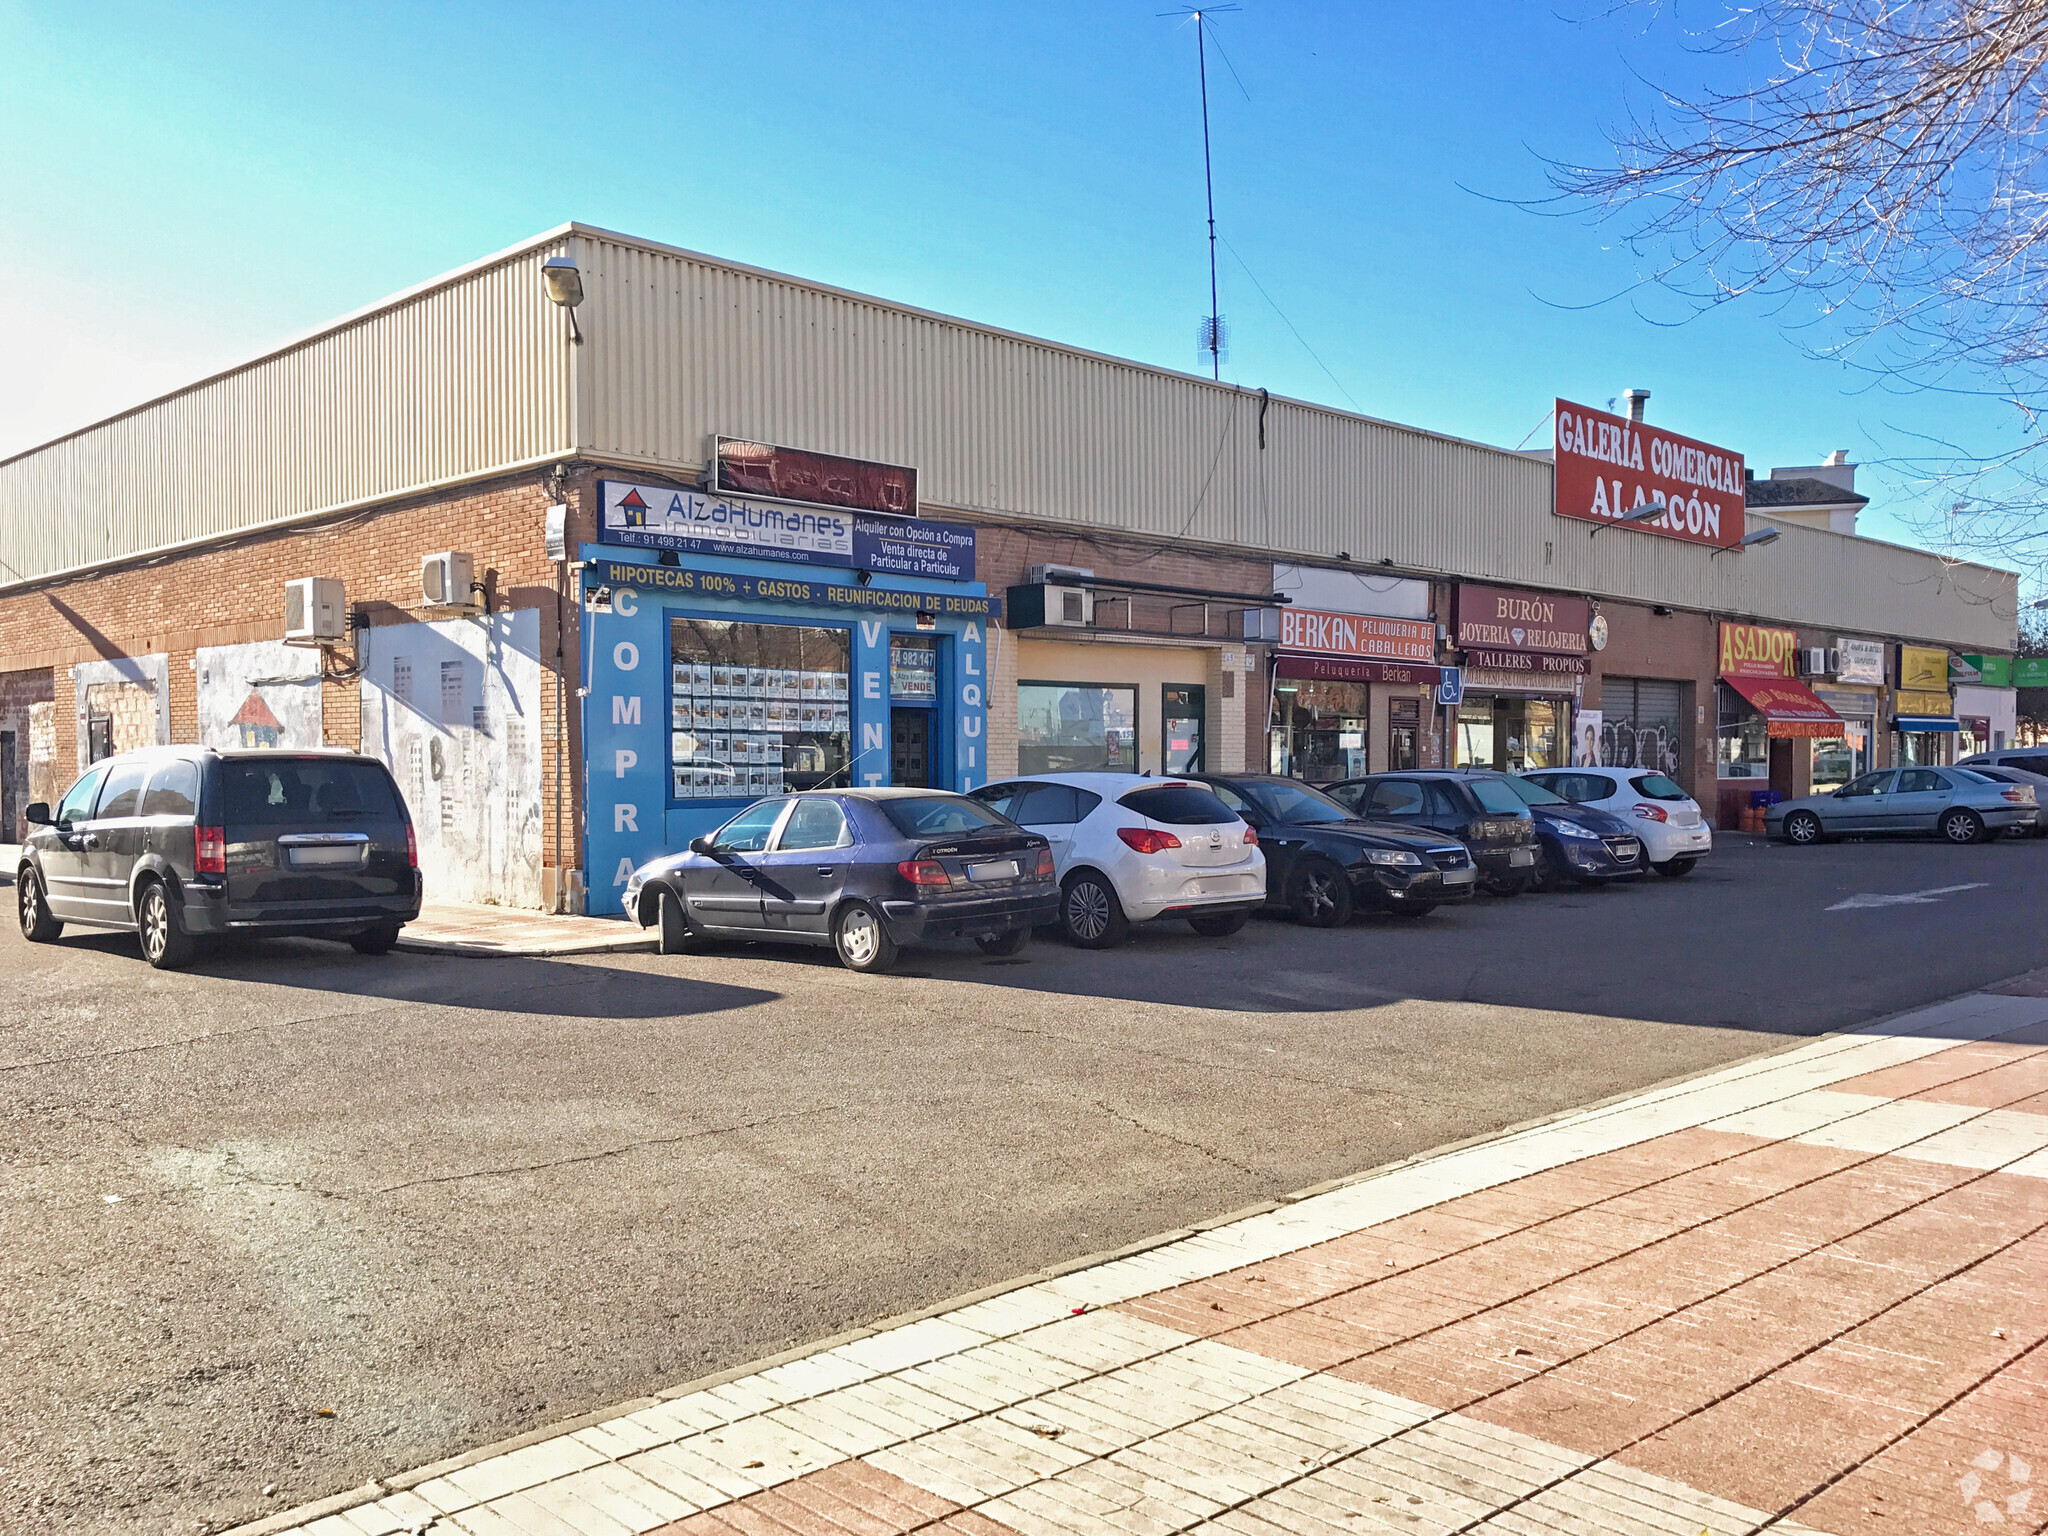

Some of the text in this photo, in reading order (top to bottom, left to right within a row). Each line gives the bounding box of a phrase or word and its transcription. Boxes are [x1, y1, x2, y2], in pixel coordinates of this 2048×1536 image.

[1558, 411, 1743, 497] GALERÍA COMERCIAL
[667, 493, 844, 537] AlzaHumanes
[618, 532, 701, 549] Telf.: 91 498 21 47
[855, 519, 973, 548] Alquiler con Opción a Compra
[713, 542, 809, 561] www.alzahumanes.com
[881, 541, 948, 561] Venta directa de
[871, 554, 960, 576] Particular a Particular
[610, 565, 694, 588] HIPOTECAS
[700, 576, 736, 593] 100%
[743, 583, 751, 594] +
[758, 580, 810, 599] GASTOS
[828, 586, 921, 609] REUNIFICACION
[926, 596, 941, 610] DE
[946, 598, 989, 614] DEUDAS
[1496, 596, 1555, 623] BURÓN
[1282, 612, 1432, 650] BERKAN PELUQUERIA DE
[1460, 622, 1587, 651] JOYERIA RELOJERIA
[903, 652, 918, 666] 982
[920, 652, 934, 666] 147
[1361, 638, 1431, 658] CABALLEROS
[1720, 625, 1795, 677] ASADOR
[1382, 664, 1411, 683] Berkan
[1477, 652, 1585, 673] TALLERES PROPIOS
[902, 682, 932, 692] VENDE
